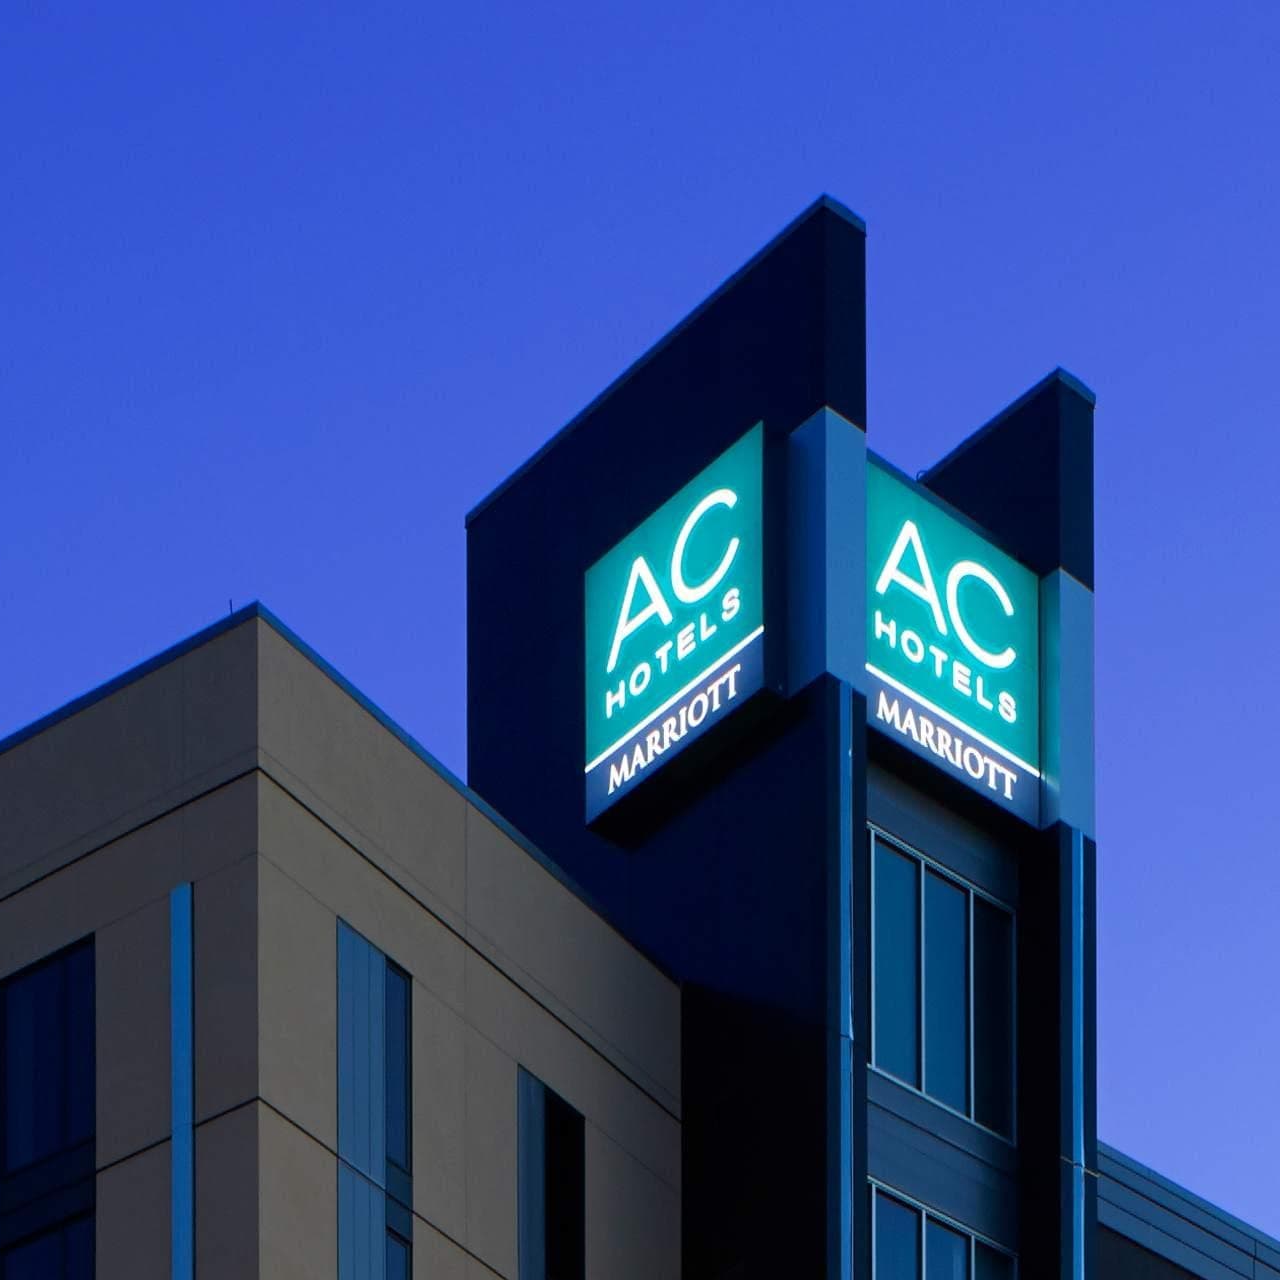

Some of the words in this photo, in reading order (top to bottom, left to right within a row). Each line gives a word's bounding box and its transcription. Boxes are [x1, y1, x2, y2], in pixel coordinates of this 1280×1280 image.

[606, 488, 740, 672] AC
[874, 519, 1017, 670] AC
[604, 587, 742, 719] HOTELS
[874, 610, 1018, 724] HOTELS
[606, 664, 742, 795] MARRIOTT
[876, 690, 1018, 802] MARRIOTT
